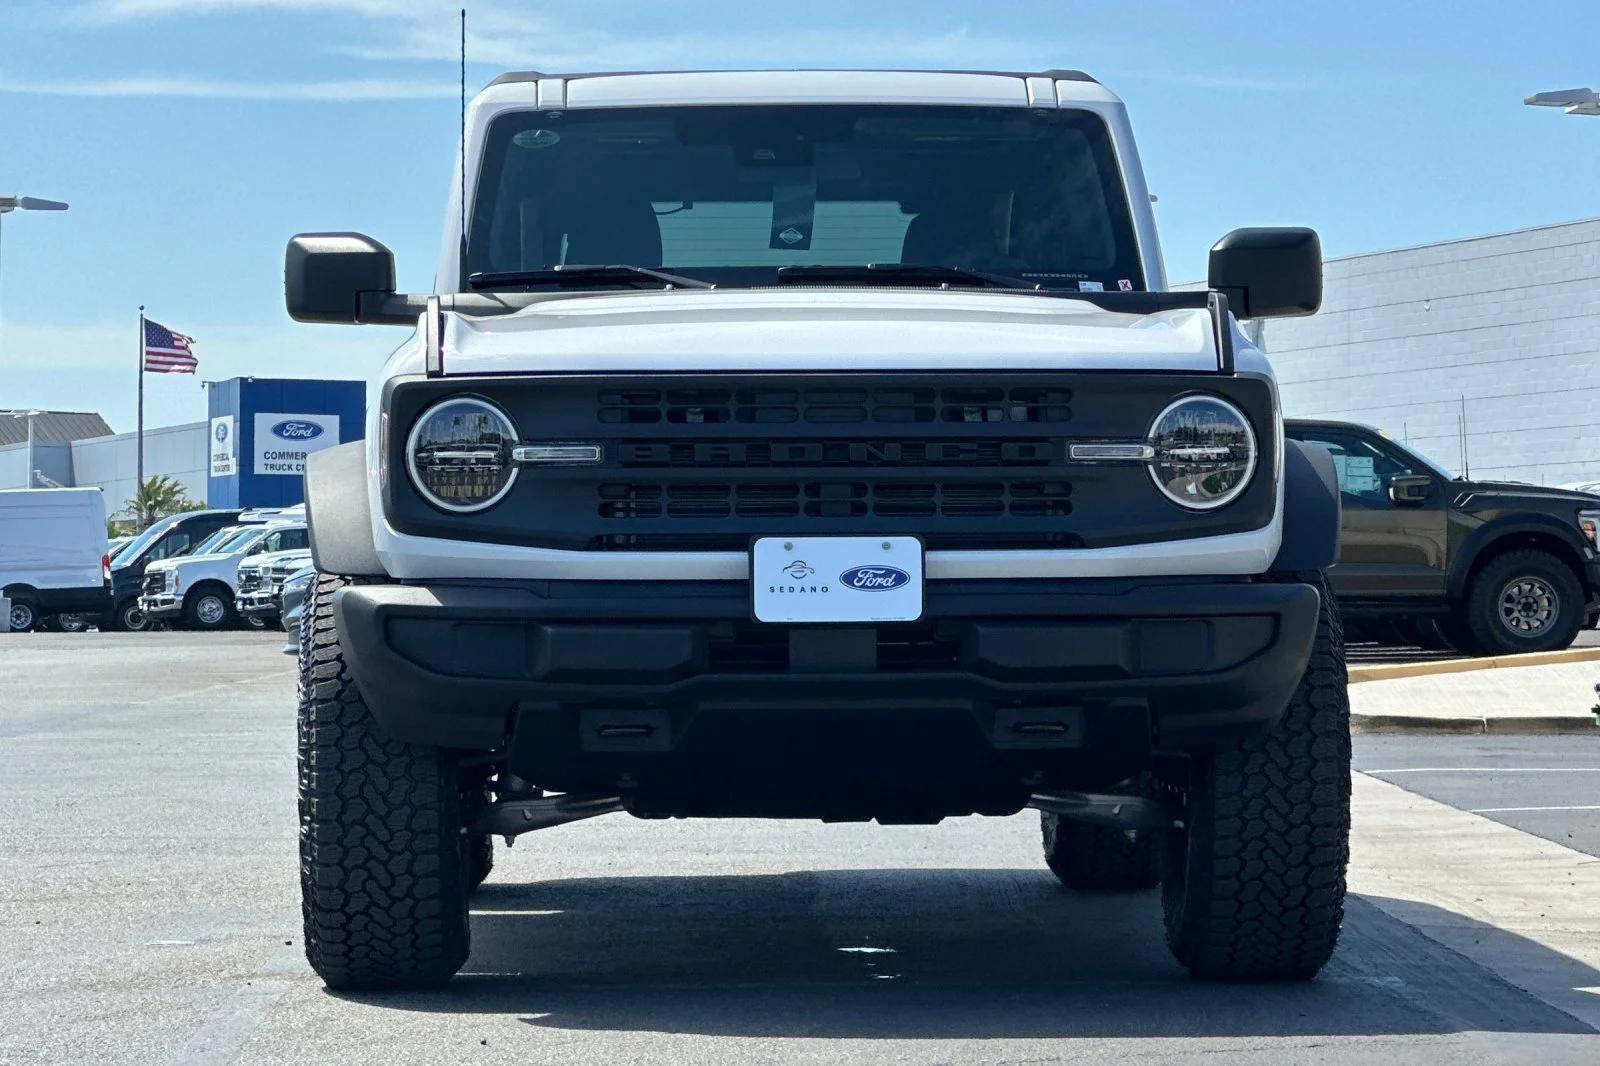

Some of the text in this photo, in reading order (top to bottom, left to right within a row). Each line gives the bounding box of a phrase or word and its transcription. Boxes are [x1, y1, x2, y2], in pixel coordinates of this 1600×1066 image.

[282, 423, 314, 437] Ford
[618, 442, 1052, 464] BRONCO
[264, 463, 293, 471] TRUCK
[853, 568, 897, 587] Ford
